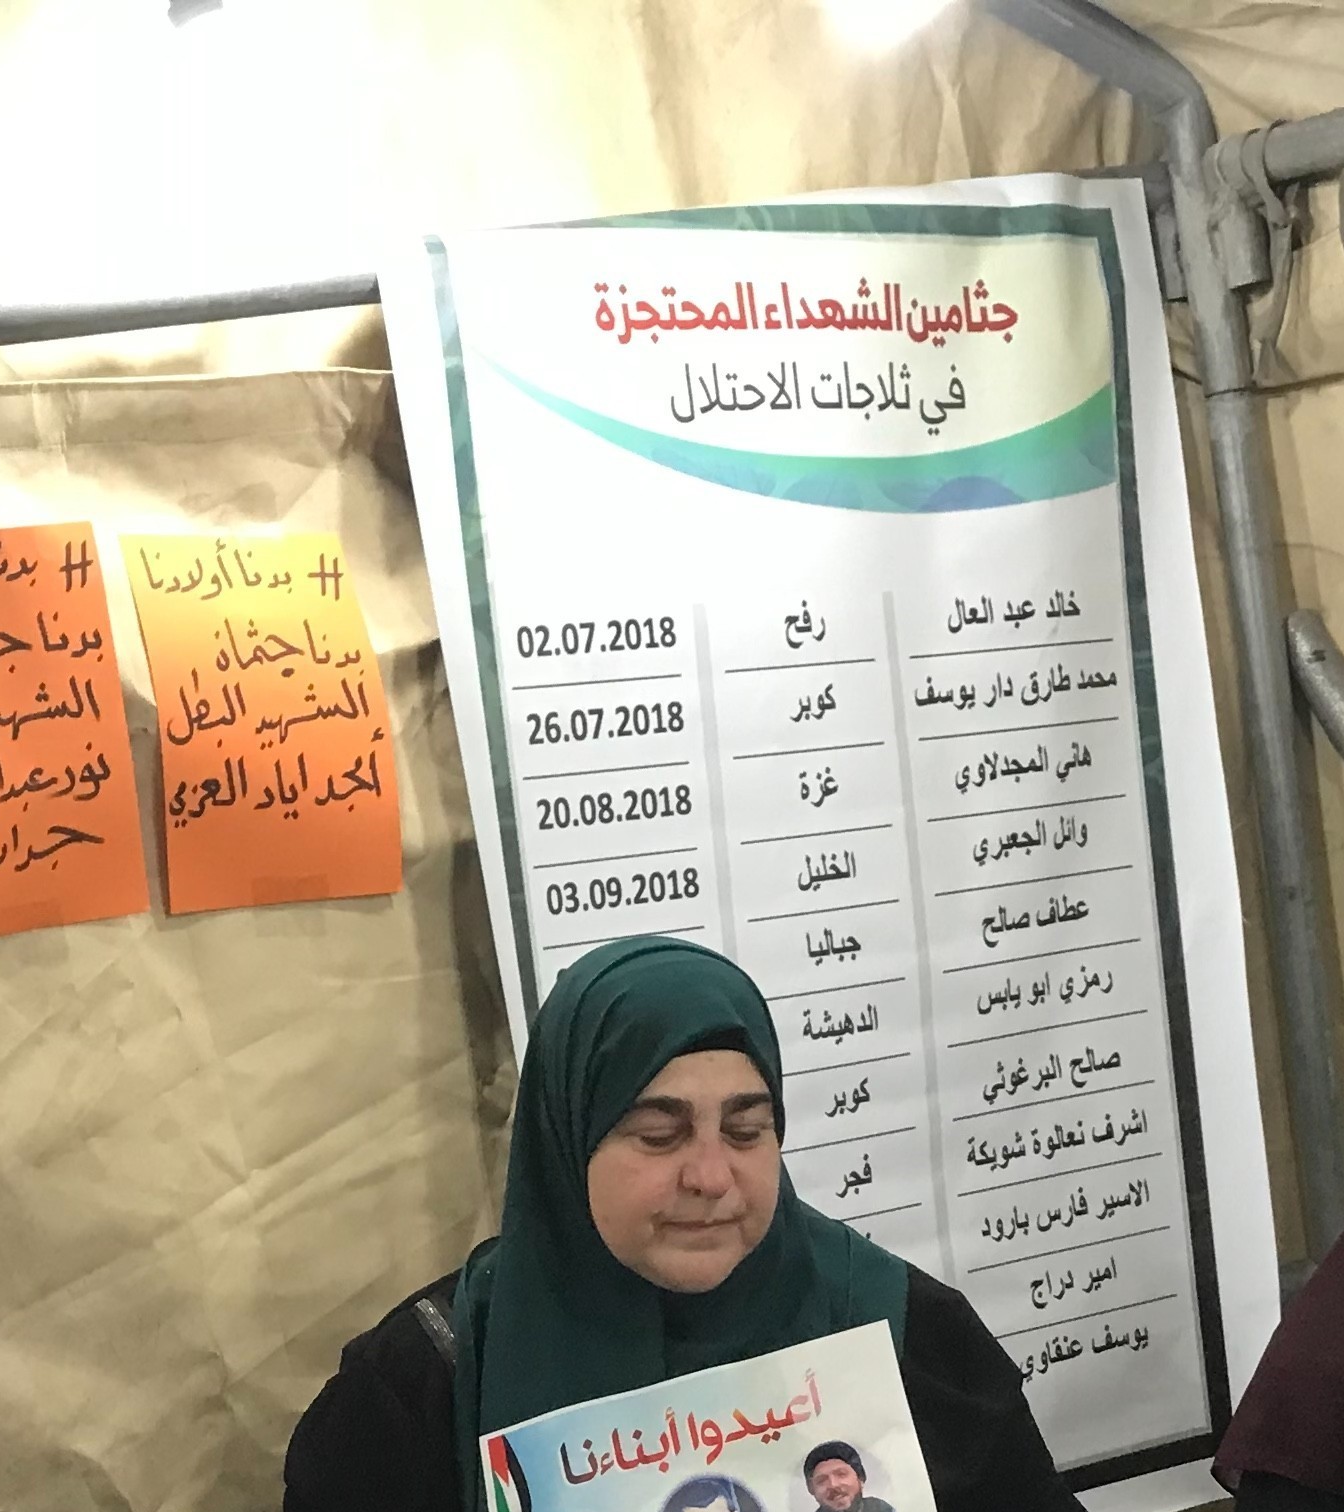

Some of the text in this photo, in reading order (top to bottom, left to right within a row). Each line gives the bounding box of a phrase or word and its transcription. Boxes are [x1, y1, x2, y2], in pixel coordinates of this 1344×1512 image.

[594, 278, 1018, 347] جثامين الشهداء المحتجزة
[671, 362, 965, 435] في ثلاجات الاحتلال
[785, 600, 825, 649] رفح
[948, 590, 1080, 633] خالد عبد العال
[517, 617, 676, 658] 02.07.2018
[791, 684, 836, 722] كوبر
[915, 664, 1118, 710] محمد طارق دار يوسف
[255, 678, 369, 750] الشهيد
[527, 702, 684, 745] 26.07.2018
[799, 767, 838, 807] غزة
[956, 742, 1091, 794] هاني المجدلاوي
[537, 785, 691, 830] 20.08.2018
[974, 819, 1046, 866] الجعبري
[547, 868, 699, 915] 03.09.2018
[798, 851, 856, 891] الخليل
[982, 895, 1089, 948] عطاف صالح
[806, 928, 861, 966] جباليا
[1027, 972, 1050, 1006] ابو
[1060, 966, 1113, 1004] رمزي
[803, 1004, 878, 1045] الدهيشة
[825, 1078, 870, 1117] كوبر
[983, 1047, 1121, 1105] صالح البرغوثي
[967, 1109, 1147, 1171] اشرف نعالوة شويكة
[836, 1154, 872, 1198] فجر
[982, 1180, 1149, 1242] الاسير فارس بارود
[1030, 1257, 1117, 1309] امير دراج
[1092, 1325, 1148, 1353] يوسف
[559, 1368, 823, 1487] أعيدوا أبناءنا
